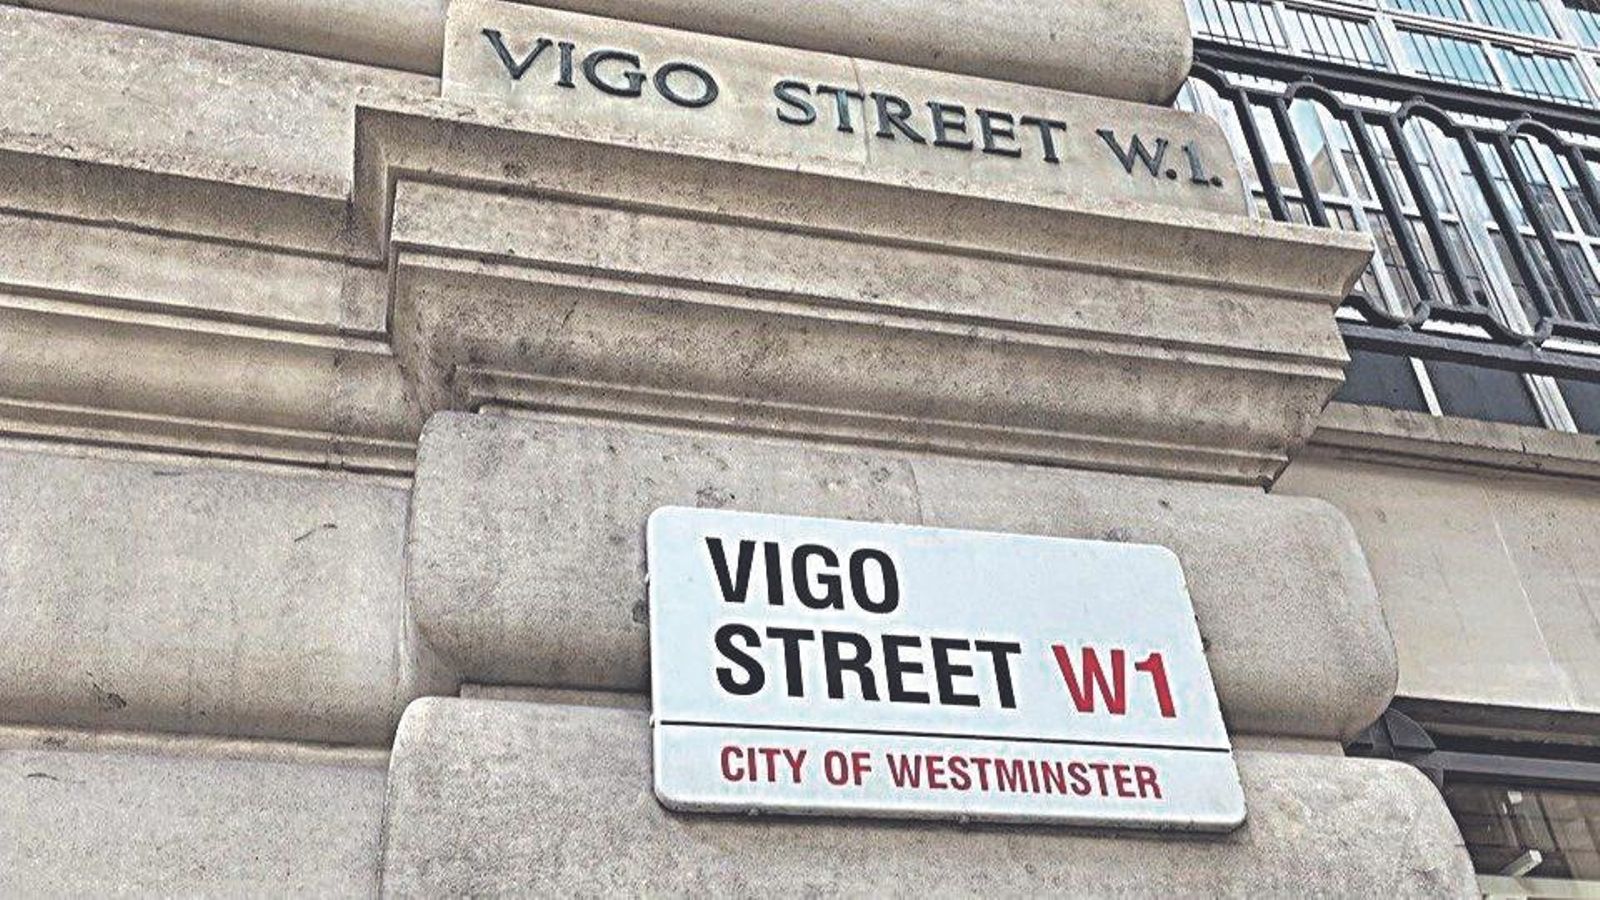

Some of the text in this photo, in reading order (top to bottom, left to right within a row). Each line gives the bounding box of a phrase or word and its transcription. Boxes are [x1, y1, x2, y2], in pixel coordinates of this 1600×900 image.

[482, 29, 1223, 187] VIGO STREET W.1.
[705, 537, 900, 614] VIGO
[714, 623, 1178, 718] STREET W1
[720, 745, 1163, 799] CITY OF WESTMINSTER
